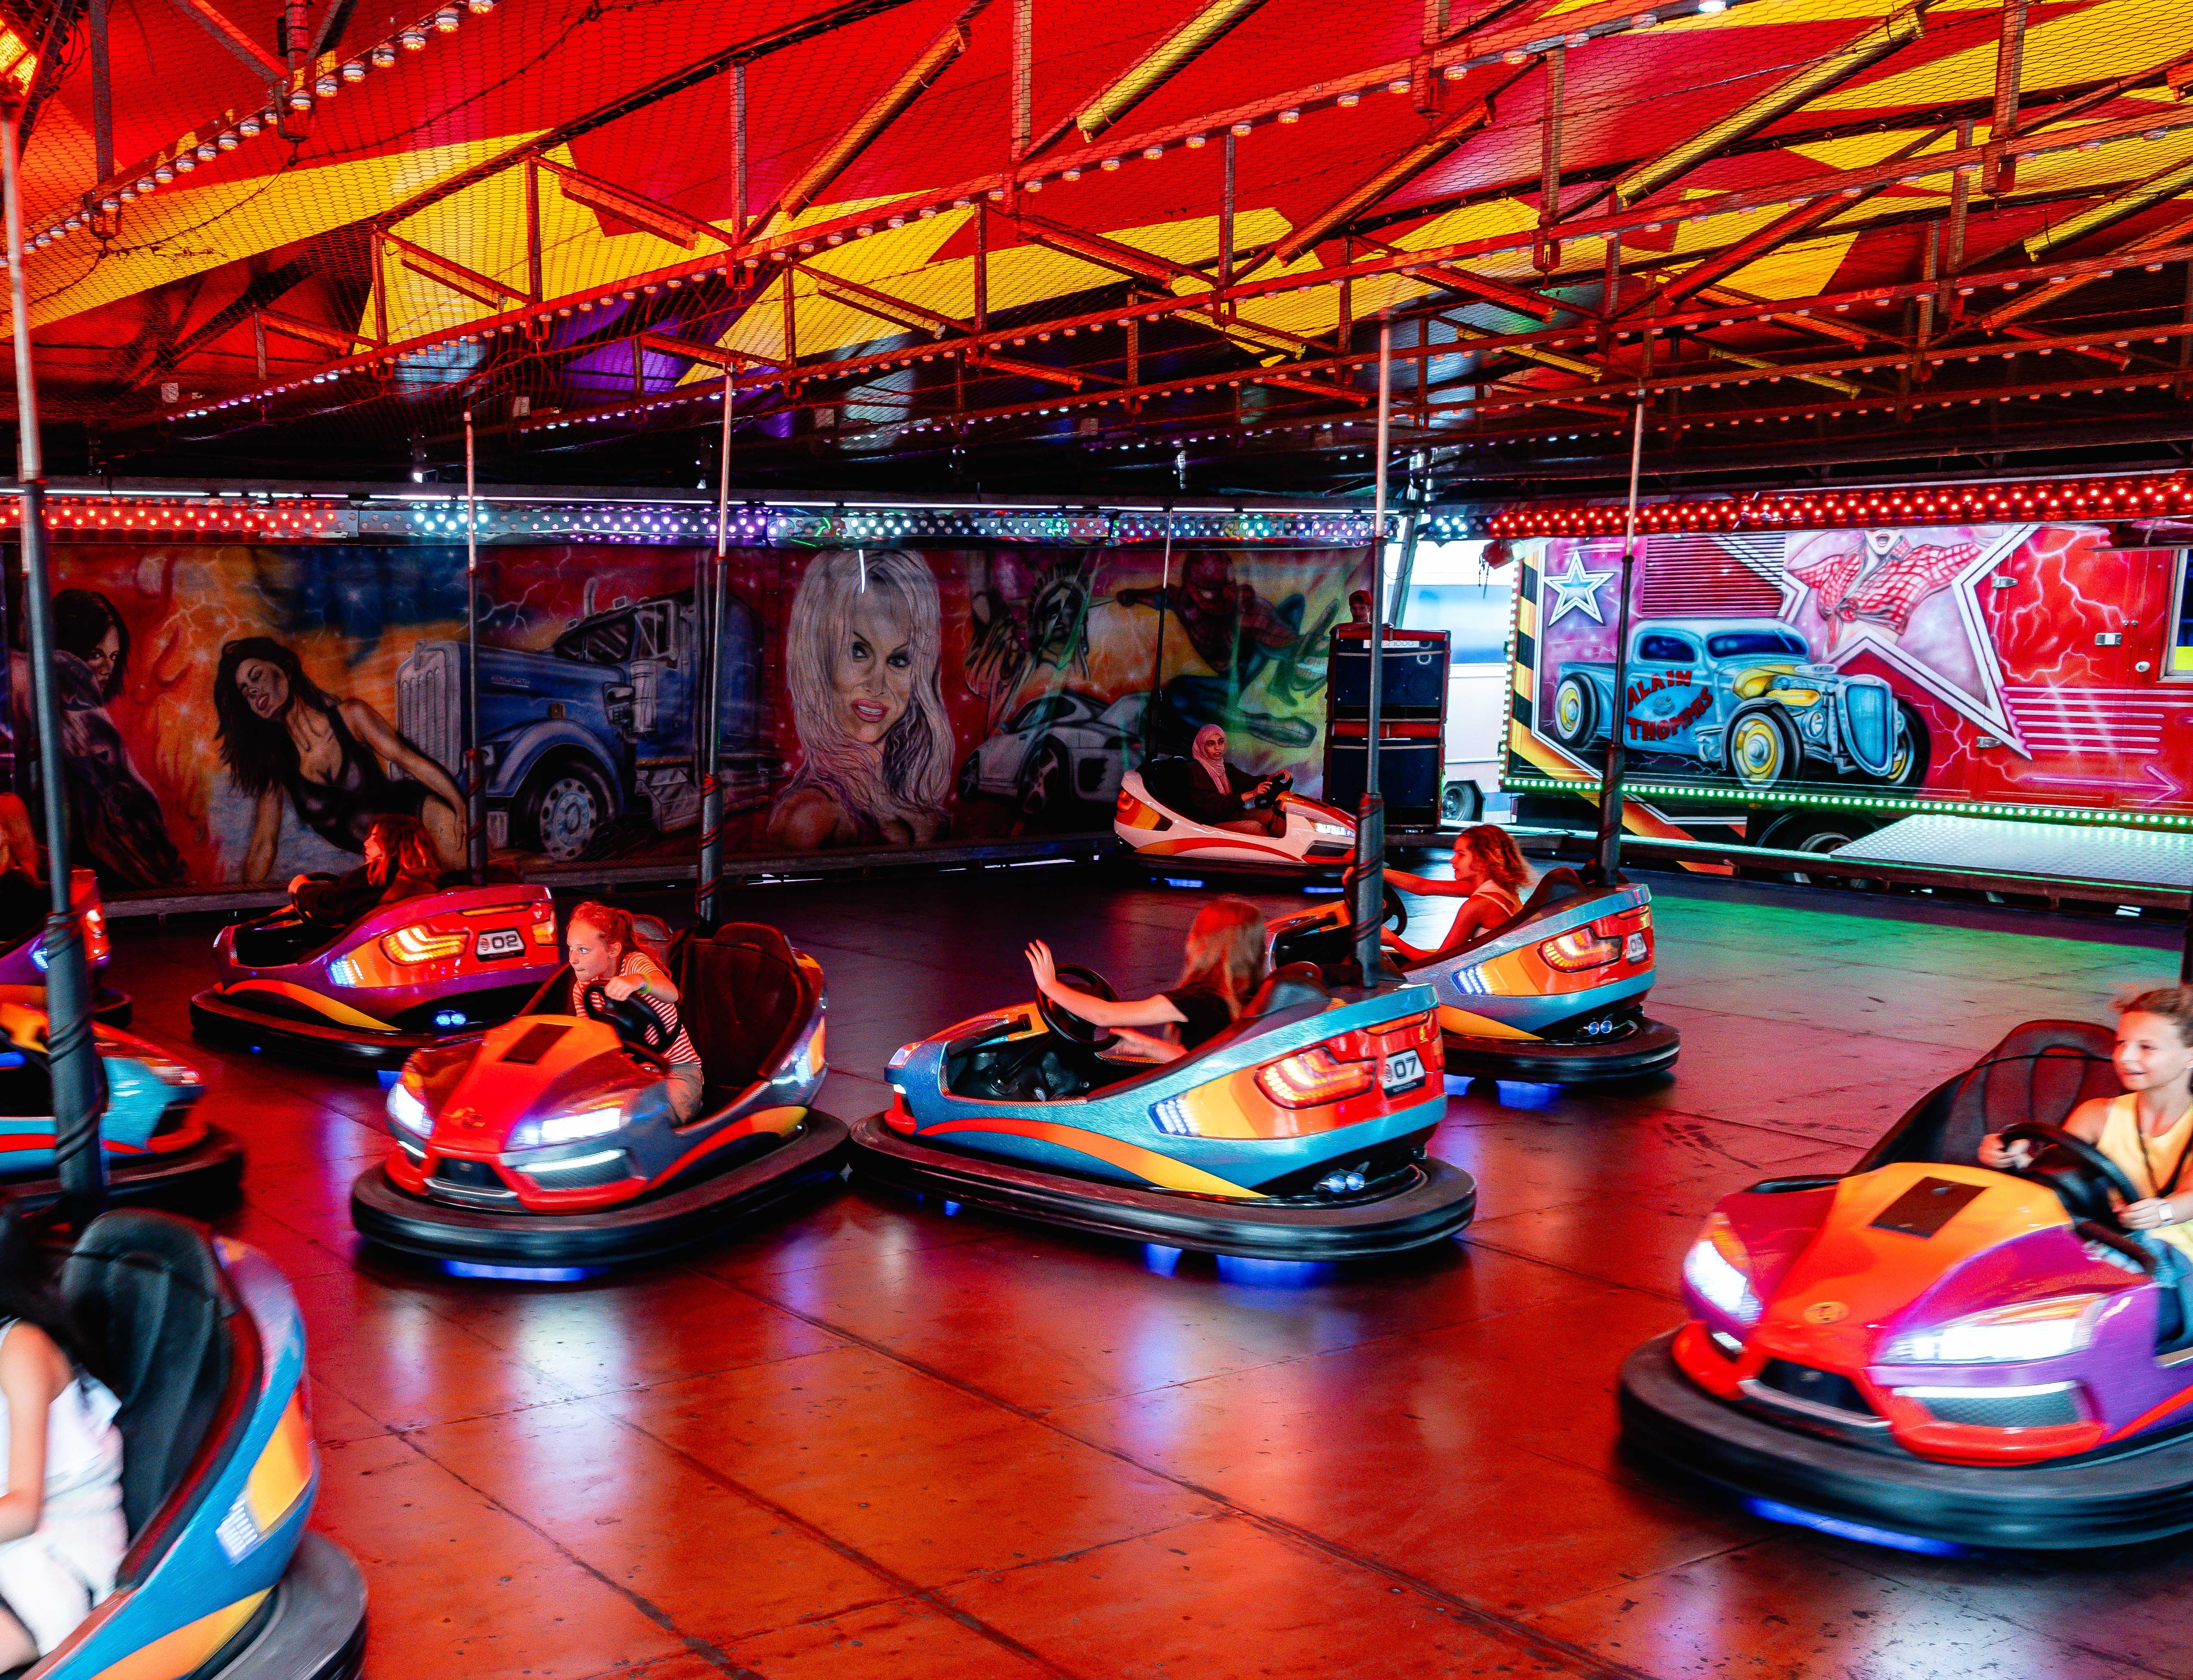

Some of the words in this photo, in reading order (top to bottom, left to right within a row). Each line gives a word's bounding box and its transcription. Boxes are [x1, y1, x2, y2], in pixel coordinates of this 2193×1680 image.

[1627, 670, 1692, 711] ALAIN
[1627, 686, 1713, 741] THOMMIS
[492, 934, 518, 949] 02
[1394, 1055, 1417, 1079] 07
